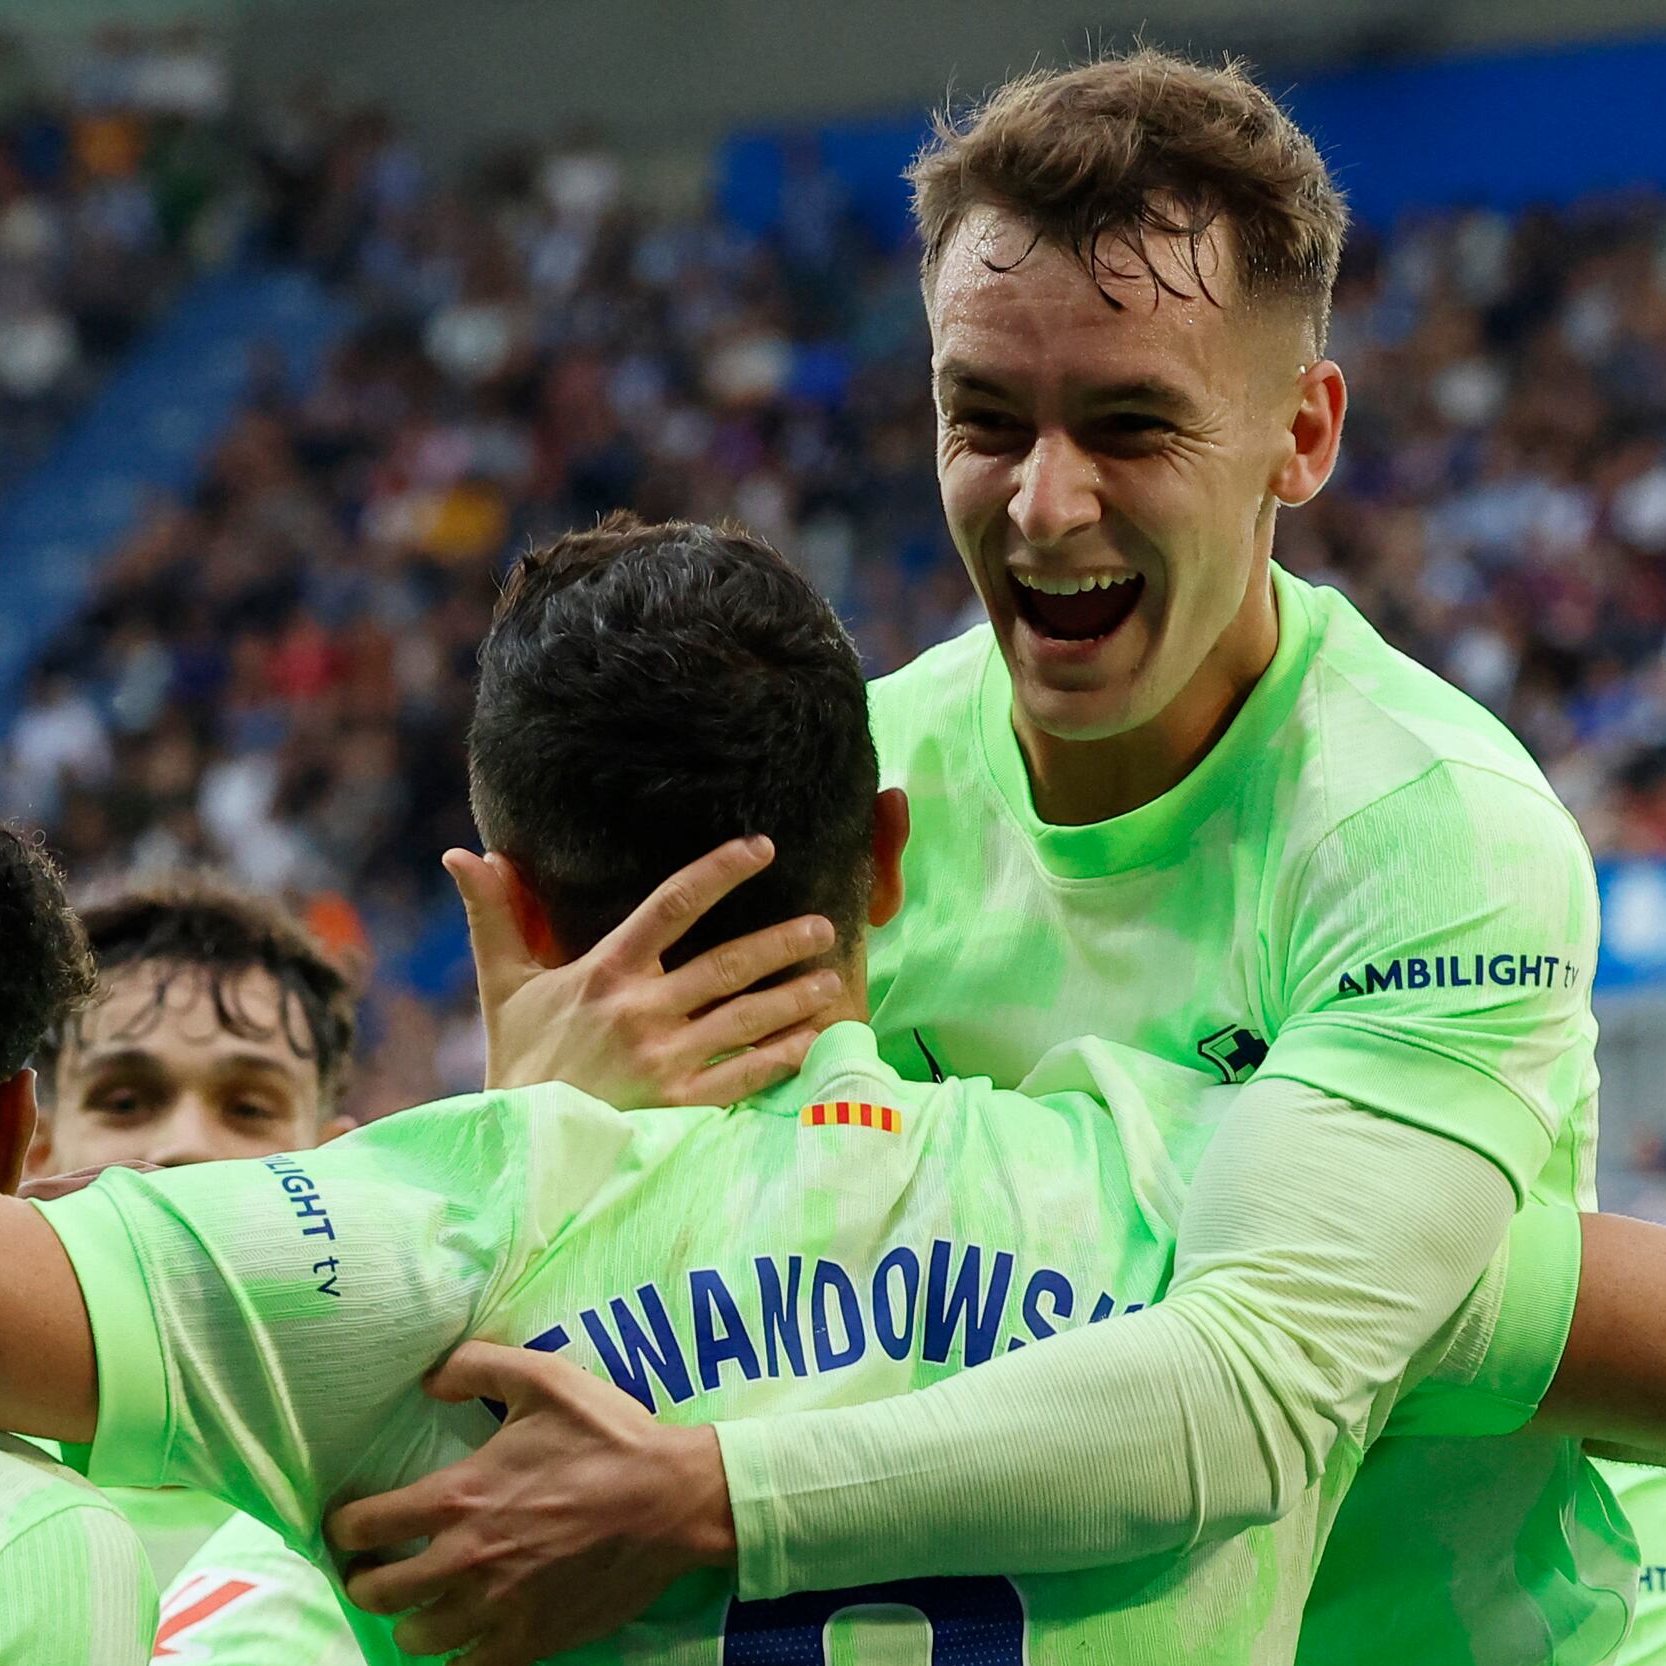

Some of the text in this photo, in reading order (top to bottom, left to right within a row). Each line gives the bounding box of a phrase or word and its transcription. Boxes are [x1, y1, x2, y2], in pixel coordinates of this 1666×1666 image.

[1337, 954, 1580, 996] AMBILIGHT tv
[312, 1256, 342, 1298] tv
